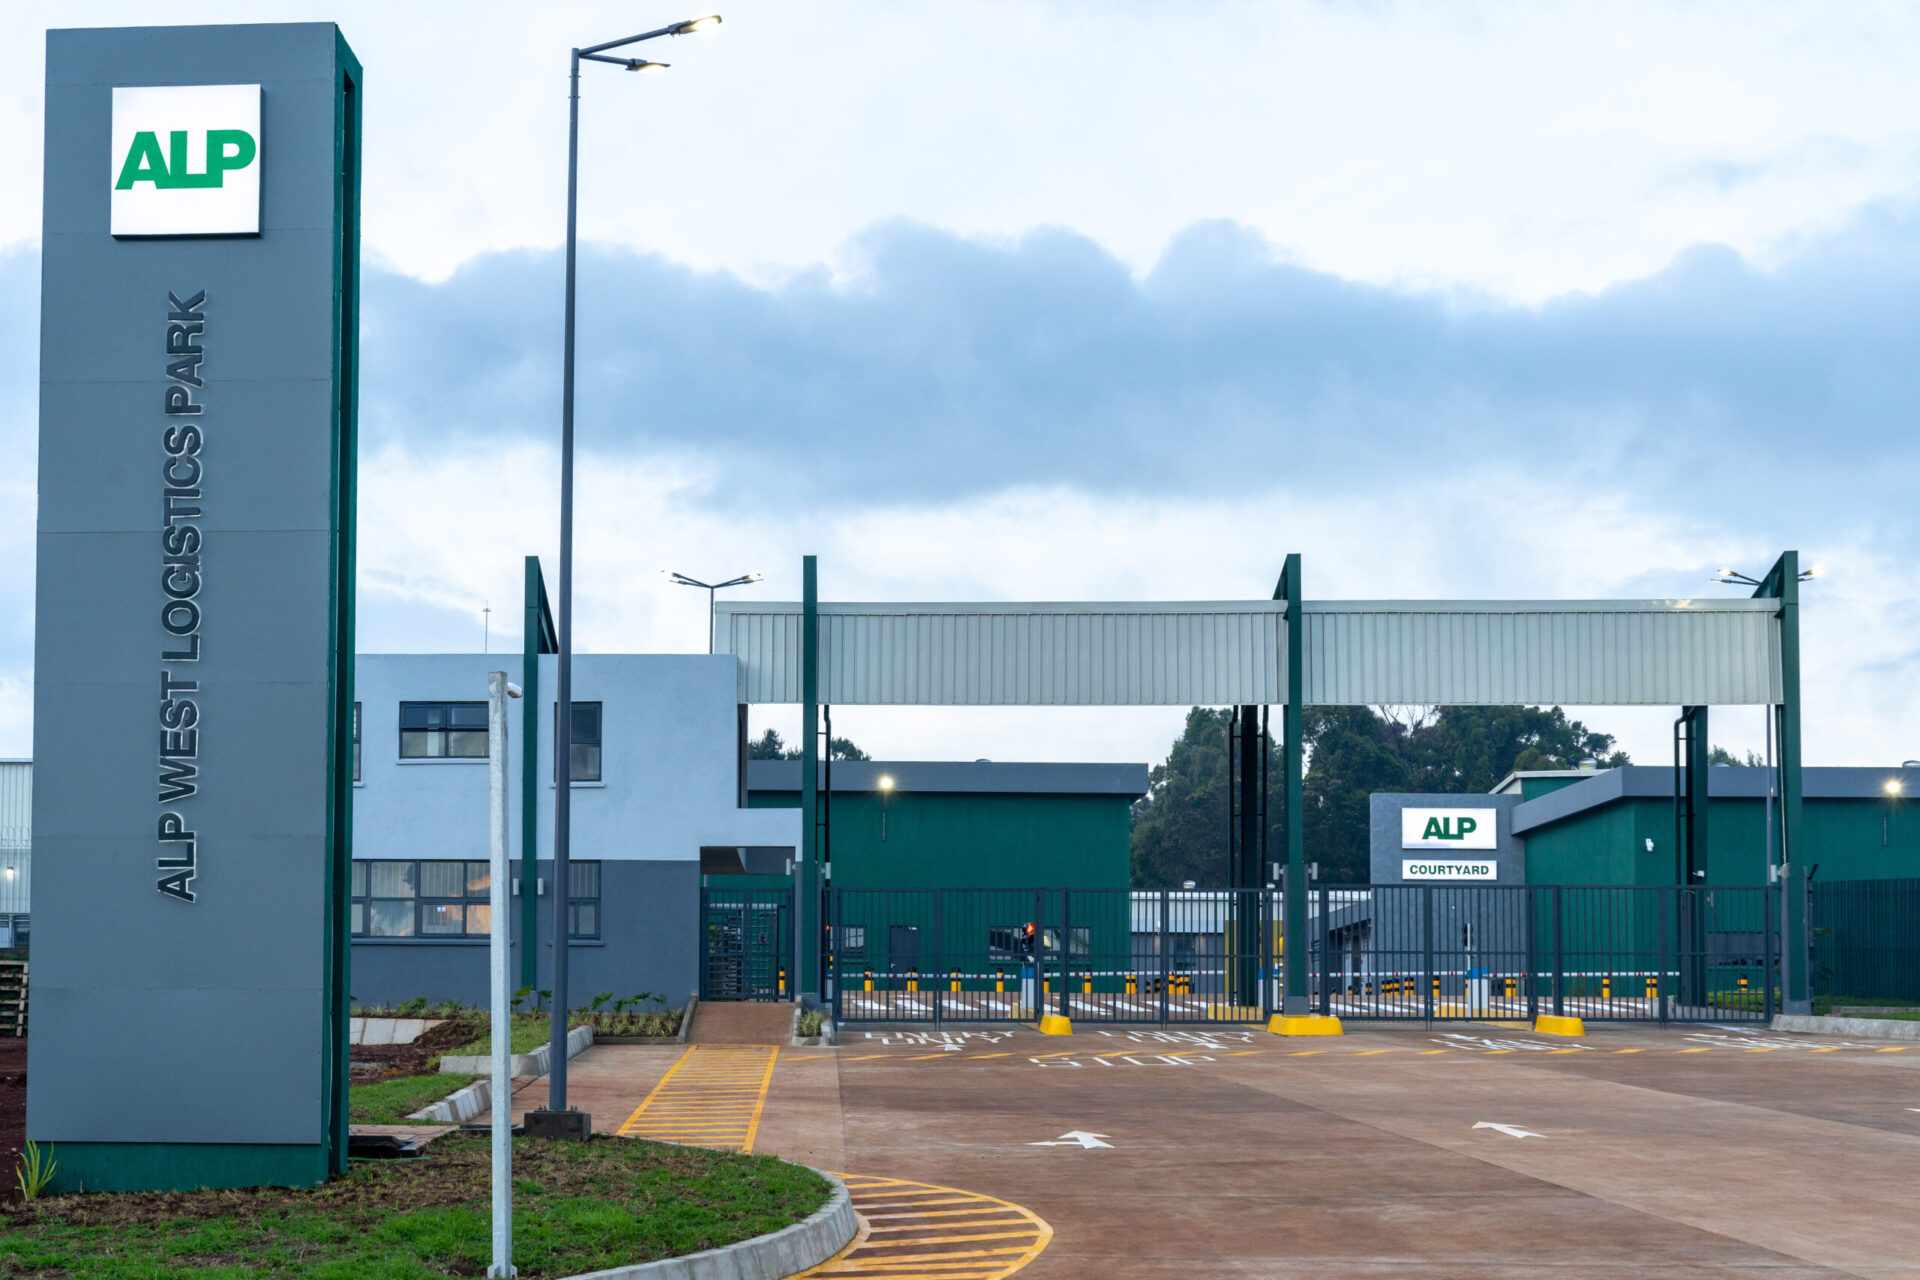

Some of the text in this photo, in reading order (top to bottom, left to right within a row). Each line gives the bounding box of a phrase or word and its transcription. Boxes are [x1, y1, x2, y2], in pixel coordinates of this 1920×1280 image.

[114, 129, 257, 190] ALP
[157, 289, 207, 903] ALP WEST LOGISTICS PARK
[1421, 816, 1477, 840] ALP
[1409, 864, 1490, 876] COURTYARD
[1027, 1055, 1217, 1068] STOP
